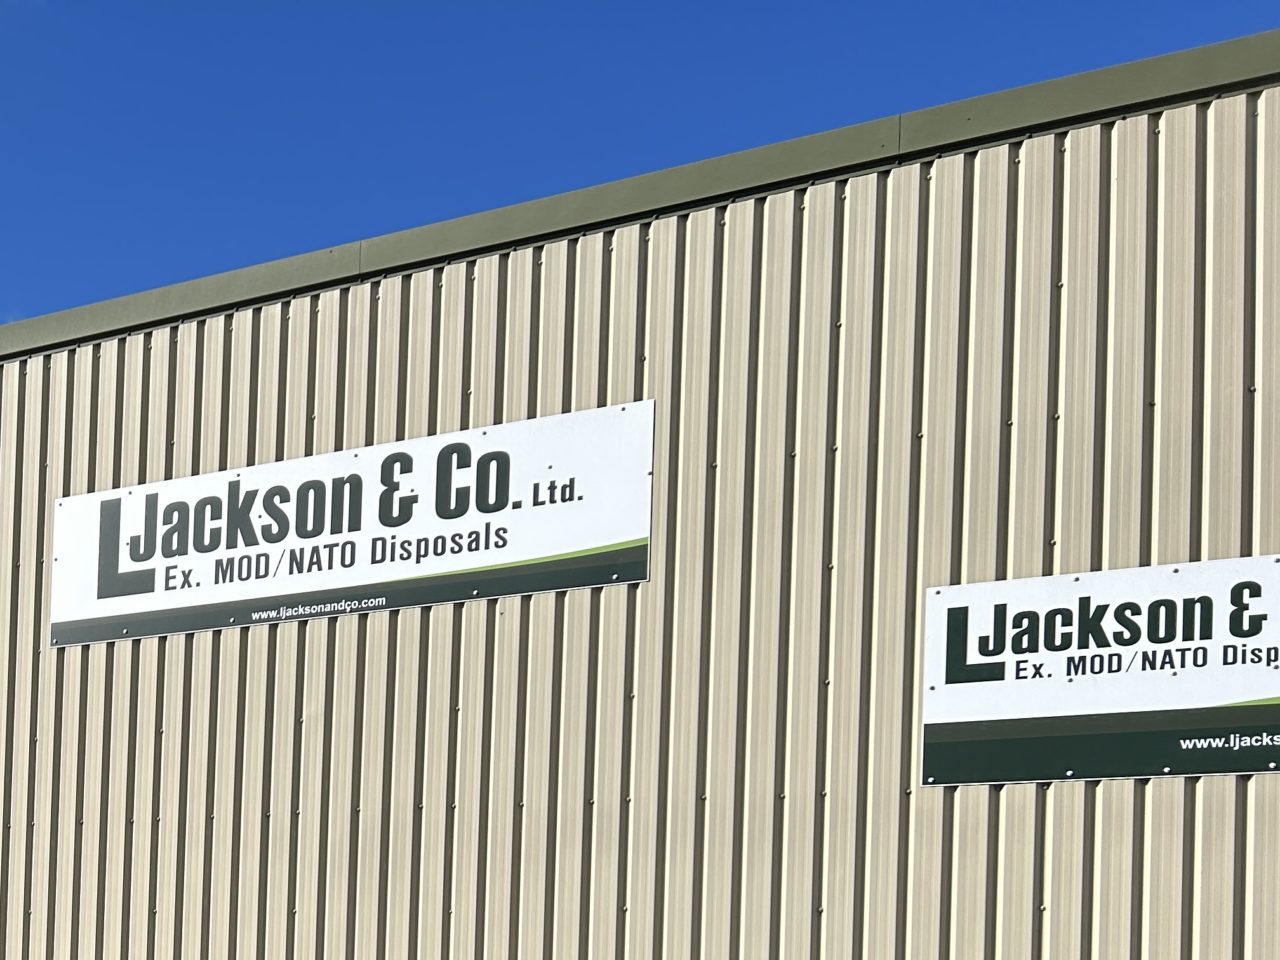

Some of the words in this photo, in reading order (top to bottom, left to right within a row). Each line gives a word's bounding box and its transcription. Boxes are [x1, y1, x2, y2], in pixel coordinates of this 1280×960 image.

[378, 452, 419, 528] &
[435, 442, 522, 520] Co.
[533, 477, 584, 507] Ltd.
[164, 565, 201, 591] Ex.
[214, 540, 357, 585] MOD/NATO
[371, 522, 508, 564] Disposals
[251, 596, 387, 620] www.ljacksonandco.com
[1229, 580, 1268, 639] &
[1015, 660, 1053, 680] Ex.
[1066, 647, 1208, 677] MOD/NATO
[1222, 643, 1279, 667] Disp
